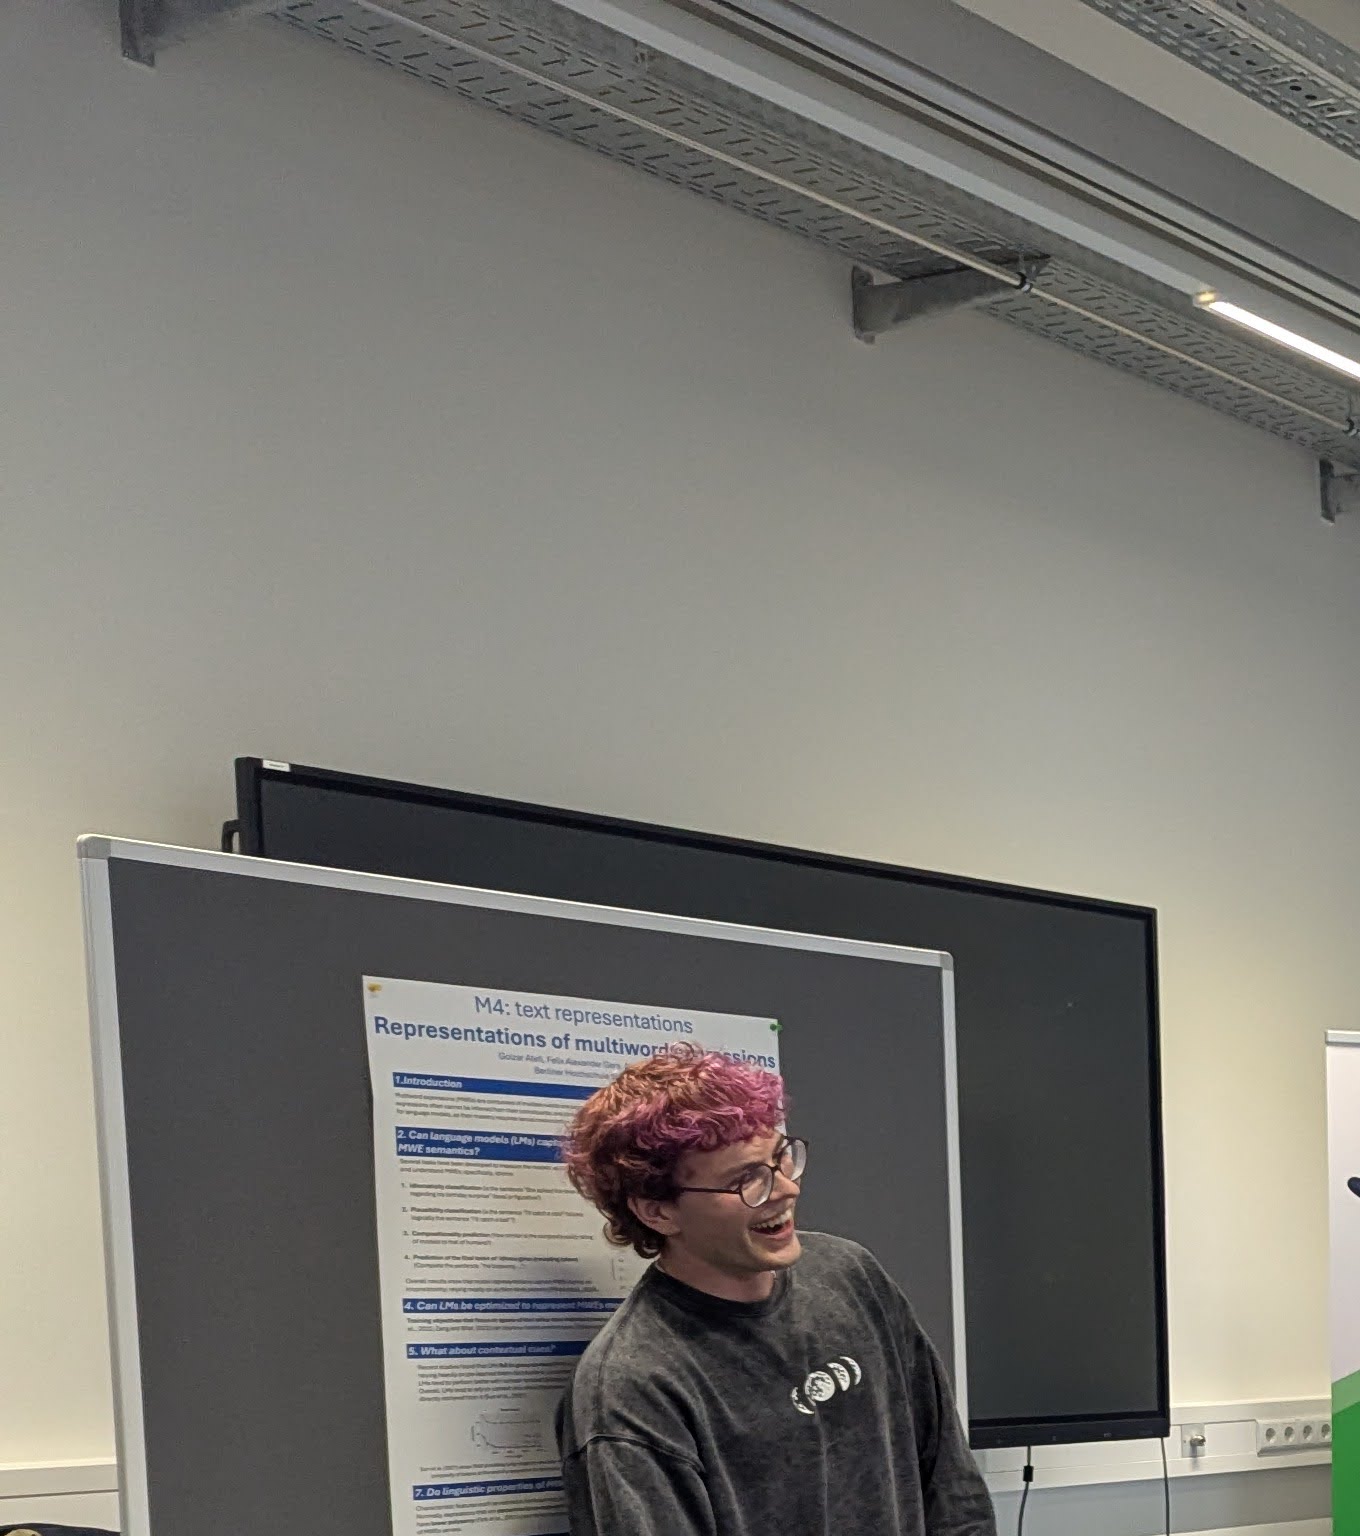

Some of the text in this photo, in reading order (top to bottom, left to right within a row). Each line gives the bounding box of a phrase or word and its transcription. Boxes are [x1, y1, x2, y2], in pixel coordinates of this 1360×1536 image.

[474, 996, 693, 1034] M4: text representations
[374, 1015, 547, 1050] Representations
[551, 1032, 570, 1050] of
[397, 1130, 535, 1147] 2. Can language models (LMs)
[398, 1143, 480, 1156] MWE semantics?
[404, 1302, 414, 1310] 4.
[417, 1302, 437, 1310] Can
[439, 1301, 459, 1310] LMs
[461, 1302, 472, 1310] be
[409, 1346, 526, 1356] 5. What about contextual
[415, 1489, 424, 1497] 7.
[426, 1488, 440, 1497] Do
[442, 1486, 485, 1497] linguistic
[487, 1483, 534, 1495] properties
